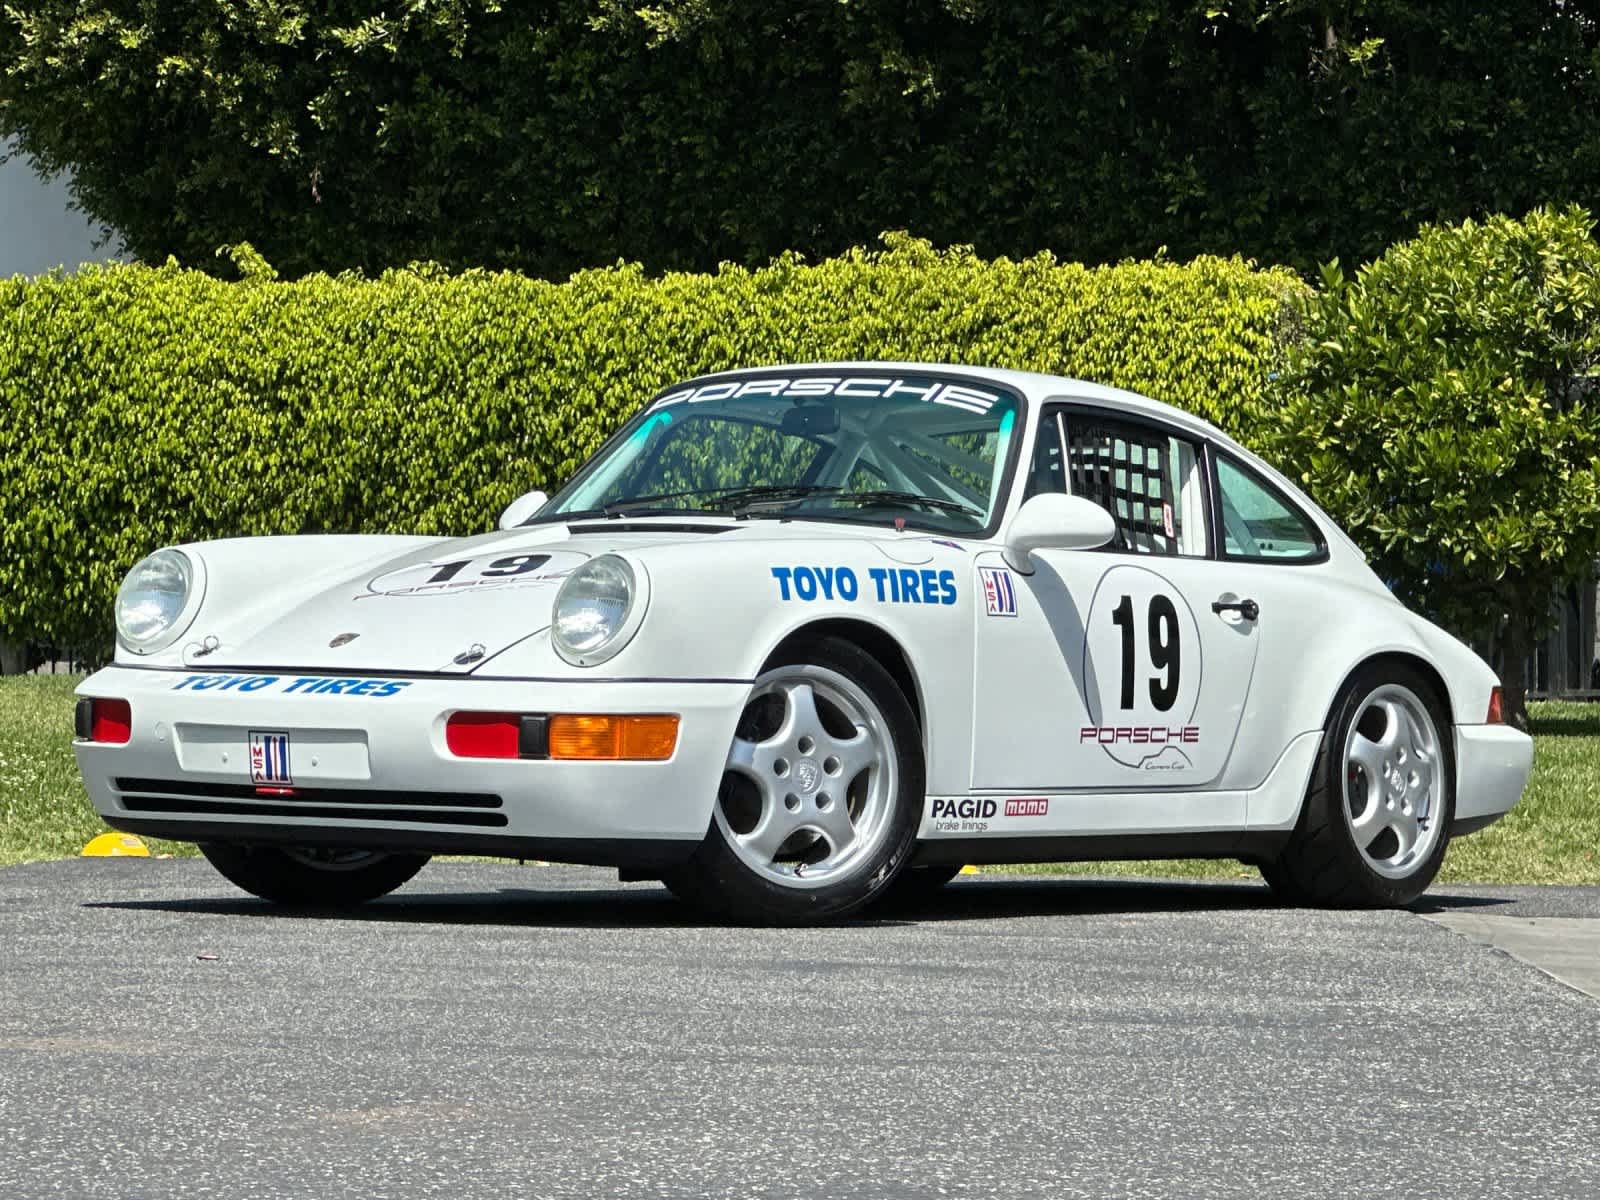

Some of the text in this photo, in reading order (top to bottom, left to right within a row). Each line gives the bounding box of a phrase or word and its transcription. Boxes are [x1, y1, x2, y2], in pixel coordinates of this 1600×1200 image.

[643, 377, 999, 415] PORSCHE
[426, 554, 552, 584] 19
[771, 566, 957, 606] TOYO TIRES
[1111, 594, 1180, 712] 19
[171, 675, 414, 697] TOYO TIRES
[1080, 727, 1200, 744] PORSCHE
[252, 735, 264, 781] IMSA
[931, 799, 997, 818] PAGID
[936, 820, 988, 833] brake linings
